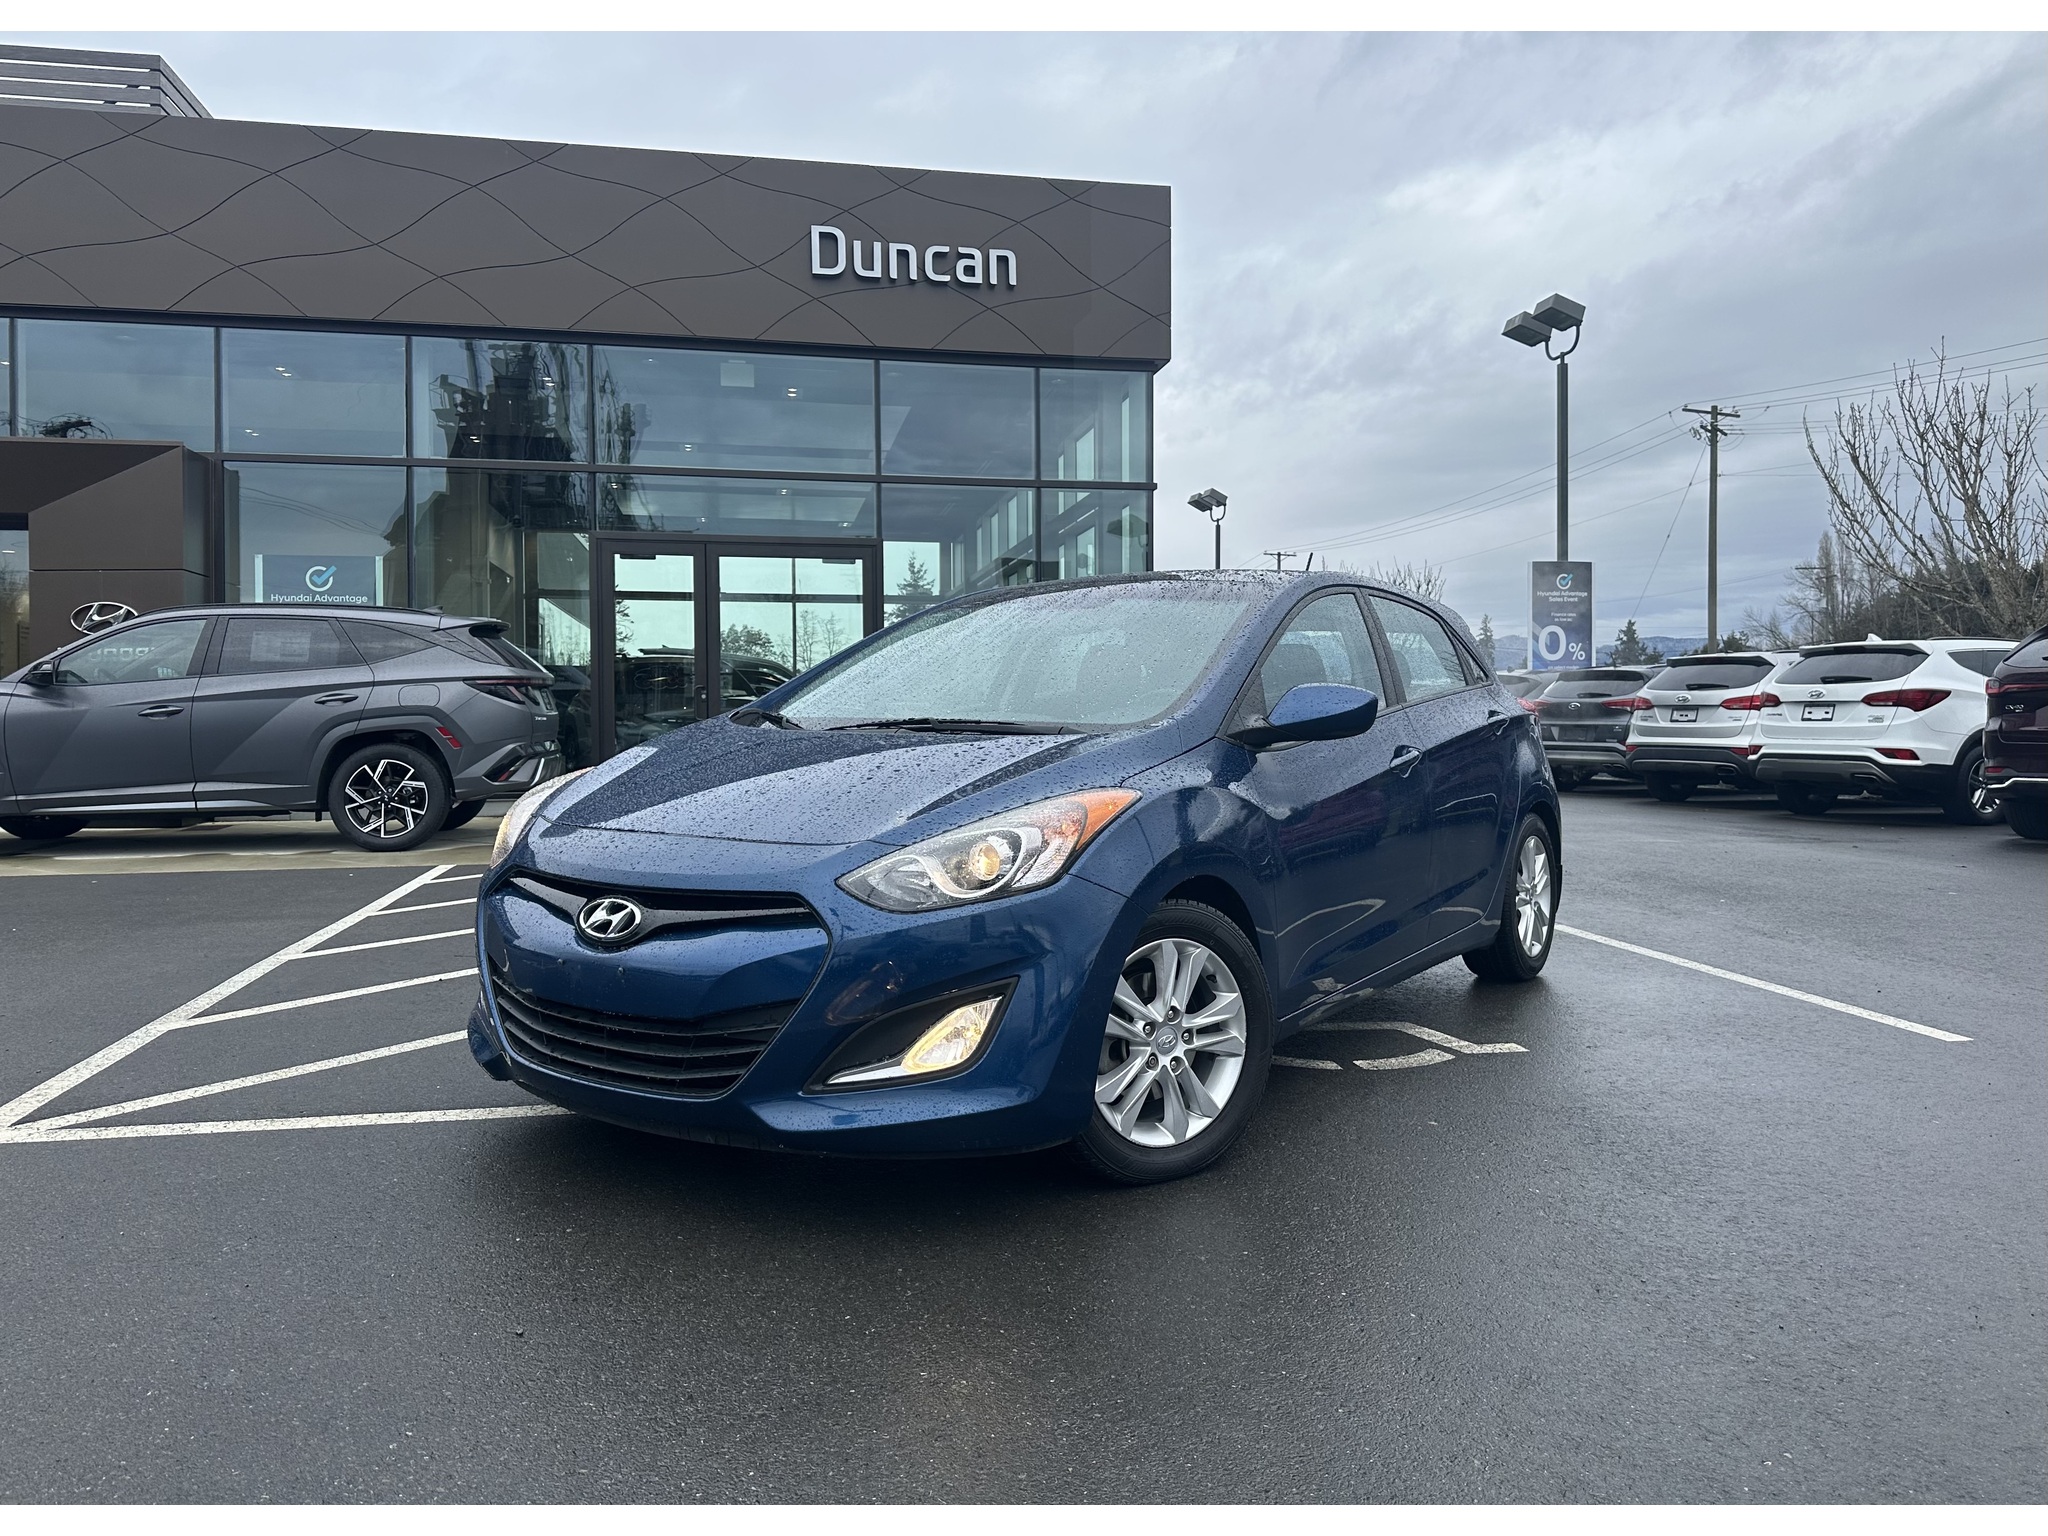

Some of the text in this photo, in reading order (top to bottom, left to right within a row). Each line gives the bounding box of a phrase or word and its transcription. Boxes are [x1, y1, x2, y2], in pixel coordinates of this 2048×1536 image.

[810, 224, 1018, 286] Duncan
[270, 593, 368, 604] Hyundai Advantage
